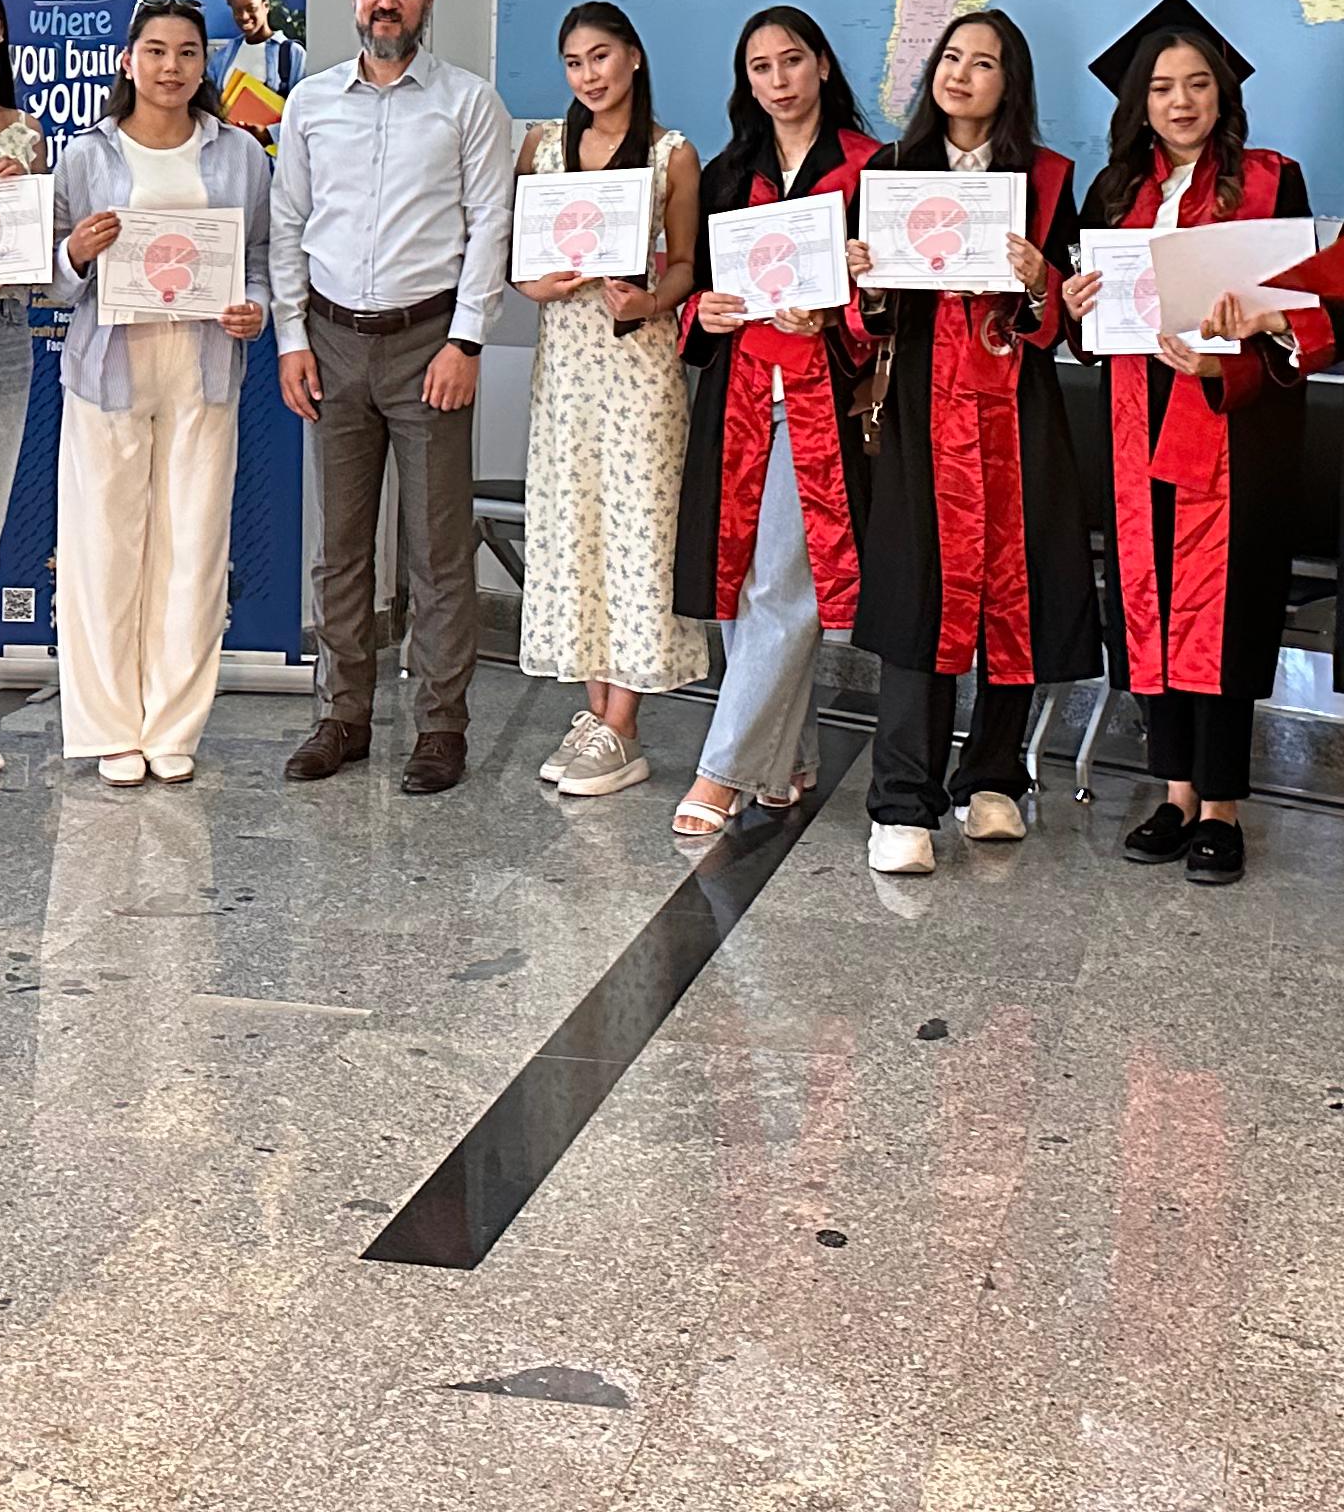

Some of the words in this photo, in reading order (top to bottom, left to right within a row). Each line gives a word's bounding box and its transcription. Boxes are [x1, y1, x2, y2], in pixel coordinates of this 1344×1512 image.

[29, 6, 112, 36] where
[9, 44, 55, 85] you
[29, 82, 110, 127] your
